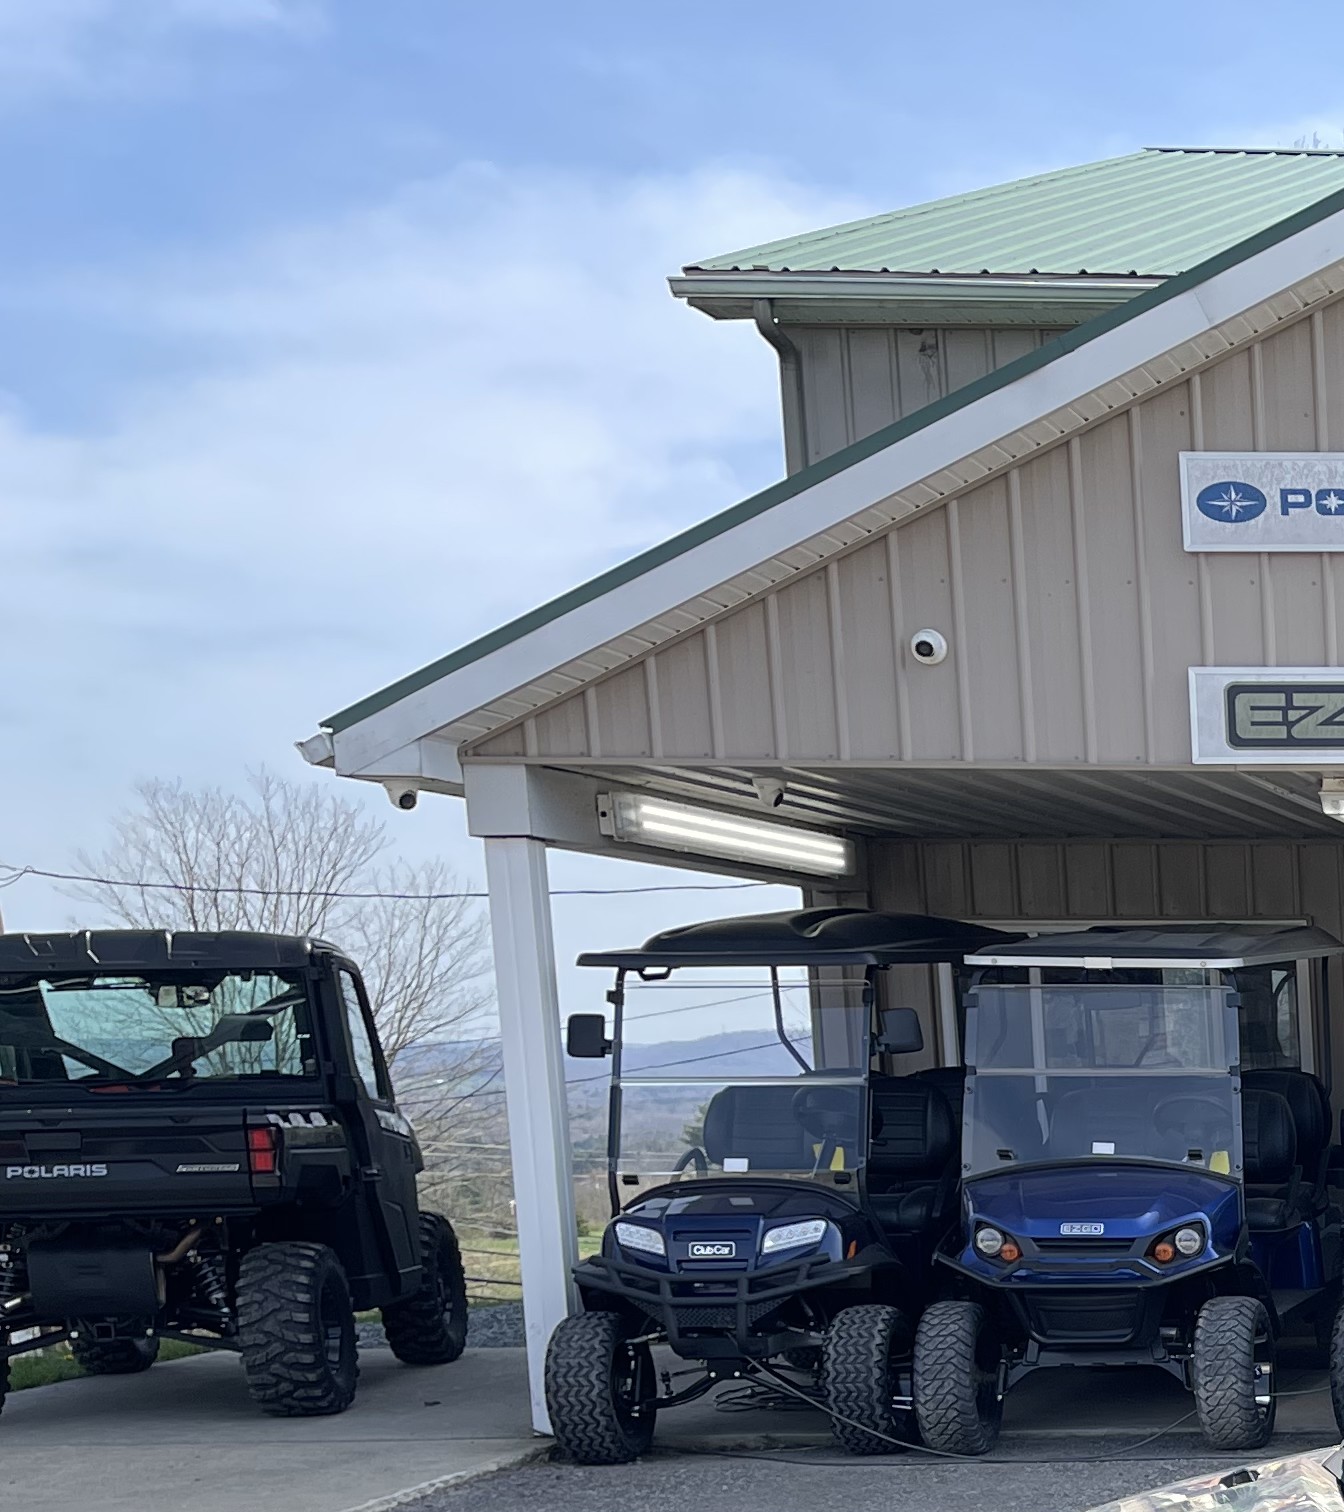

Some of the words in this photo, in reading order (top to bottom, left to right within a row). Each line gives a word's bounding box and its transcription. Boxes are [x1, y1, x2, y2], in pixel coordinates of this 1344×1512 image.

[6, 1163, 108, 1179] POLARIS
[693, 1245, 714, 1255] Club
[713, 1245, 730, 1255] Car
